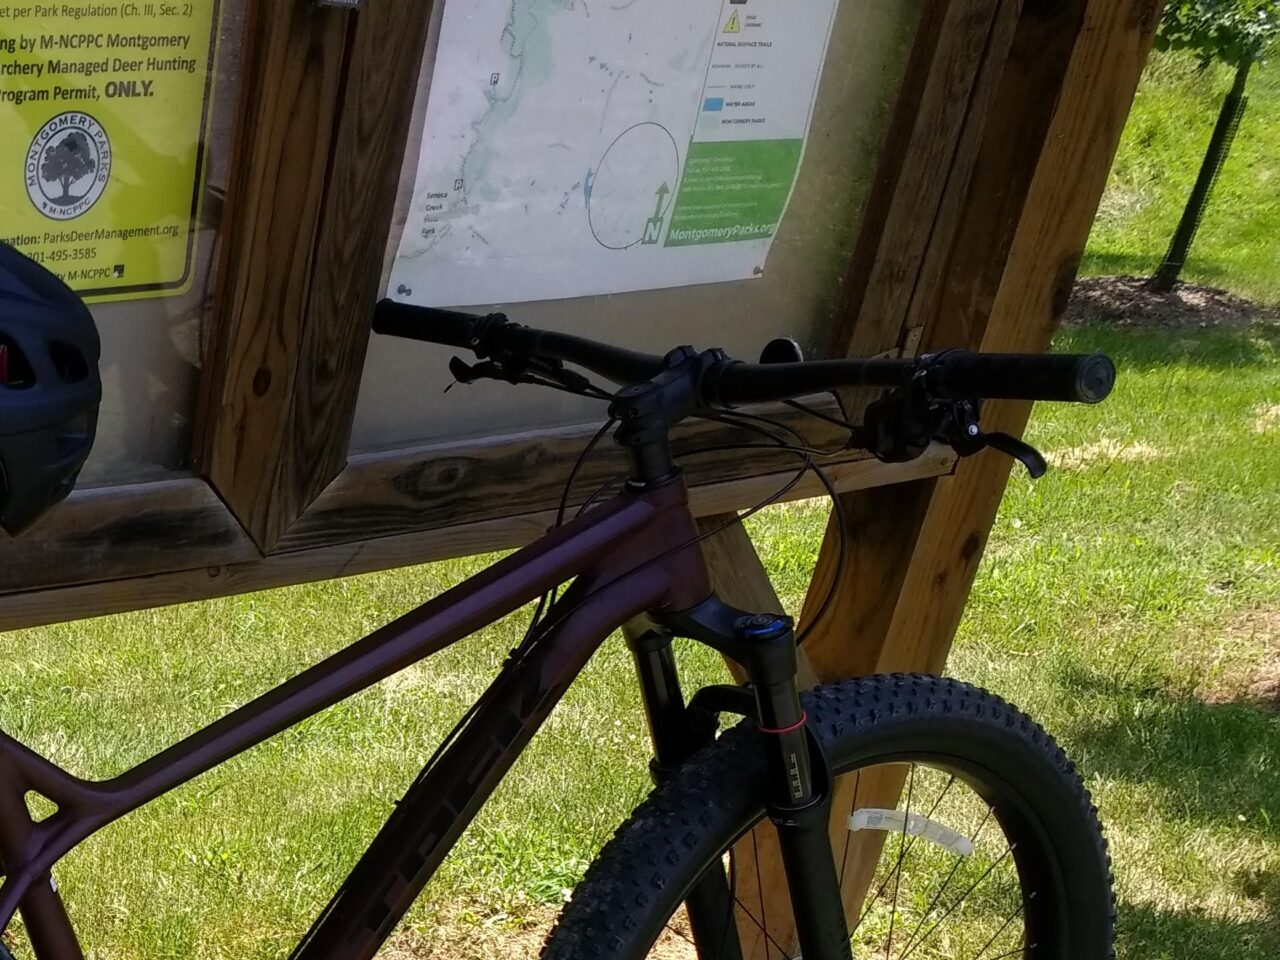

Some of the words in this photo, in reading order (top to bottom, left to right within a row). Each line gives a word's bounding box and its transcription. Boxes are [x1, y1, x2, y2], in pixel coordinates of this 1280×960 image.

[13, 8, 31, 20] per
[34, 5, 58, 17] Park
[61, 4, 117, 19] Regulation
[120, 3, 141, 18] (Ch.
[159, 4, 180, 16] Sec.
[183, 3, 193, 17] 2)
[20, 35, 36, 52] by
[40, 34, 103, 49] M-NCPPC
[107, 33, 190, 50] Montgomery
[47, 59, 108, 76] Managed
[112, 58, 143, 72] Deer
[146, 56, 196, 73] Hunting
[53, 85, 100, 101] Permit,
[105, 79, 154, 98] ONLY.
[27, 114, 95, 187] MONTGOMERY
[94, 130, 109, 183] PARKS
[44, 225, 179, 244] ParksDeerManagement.org
[645, 221, 660, 240] N
[669, 222, 777, 242] MontgomeryParks.org
